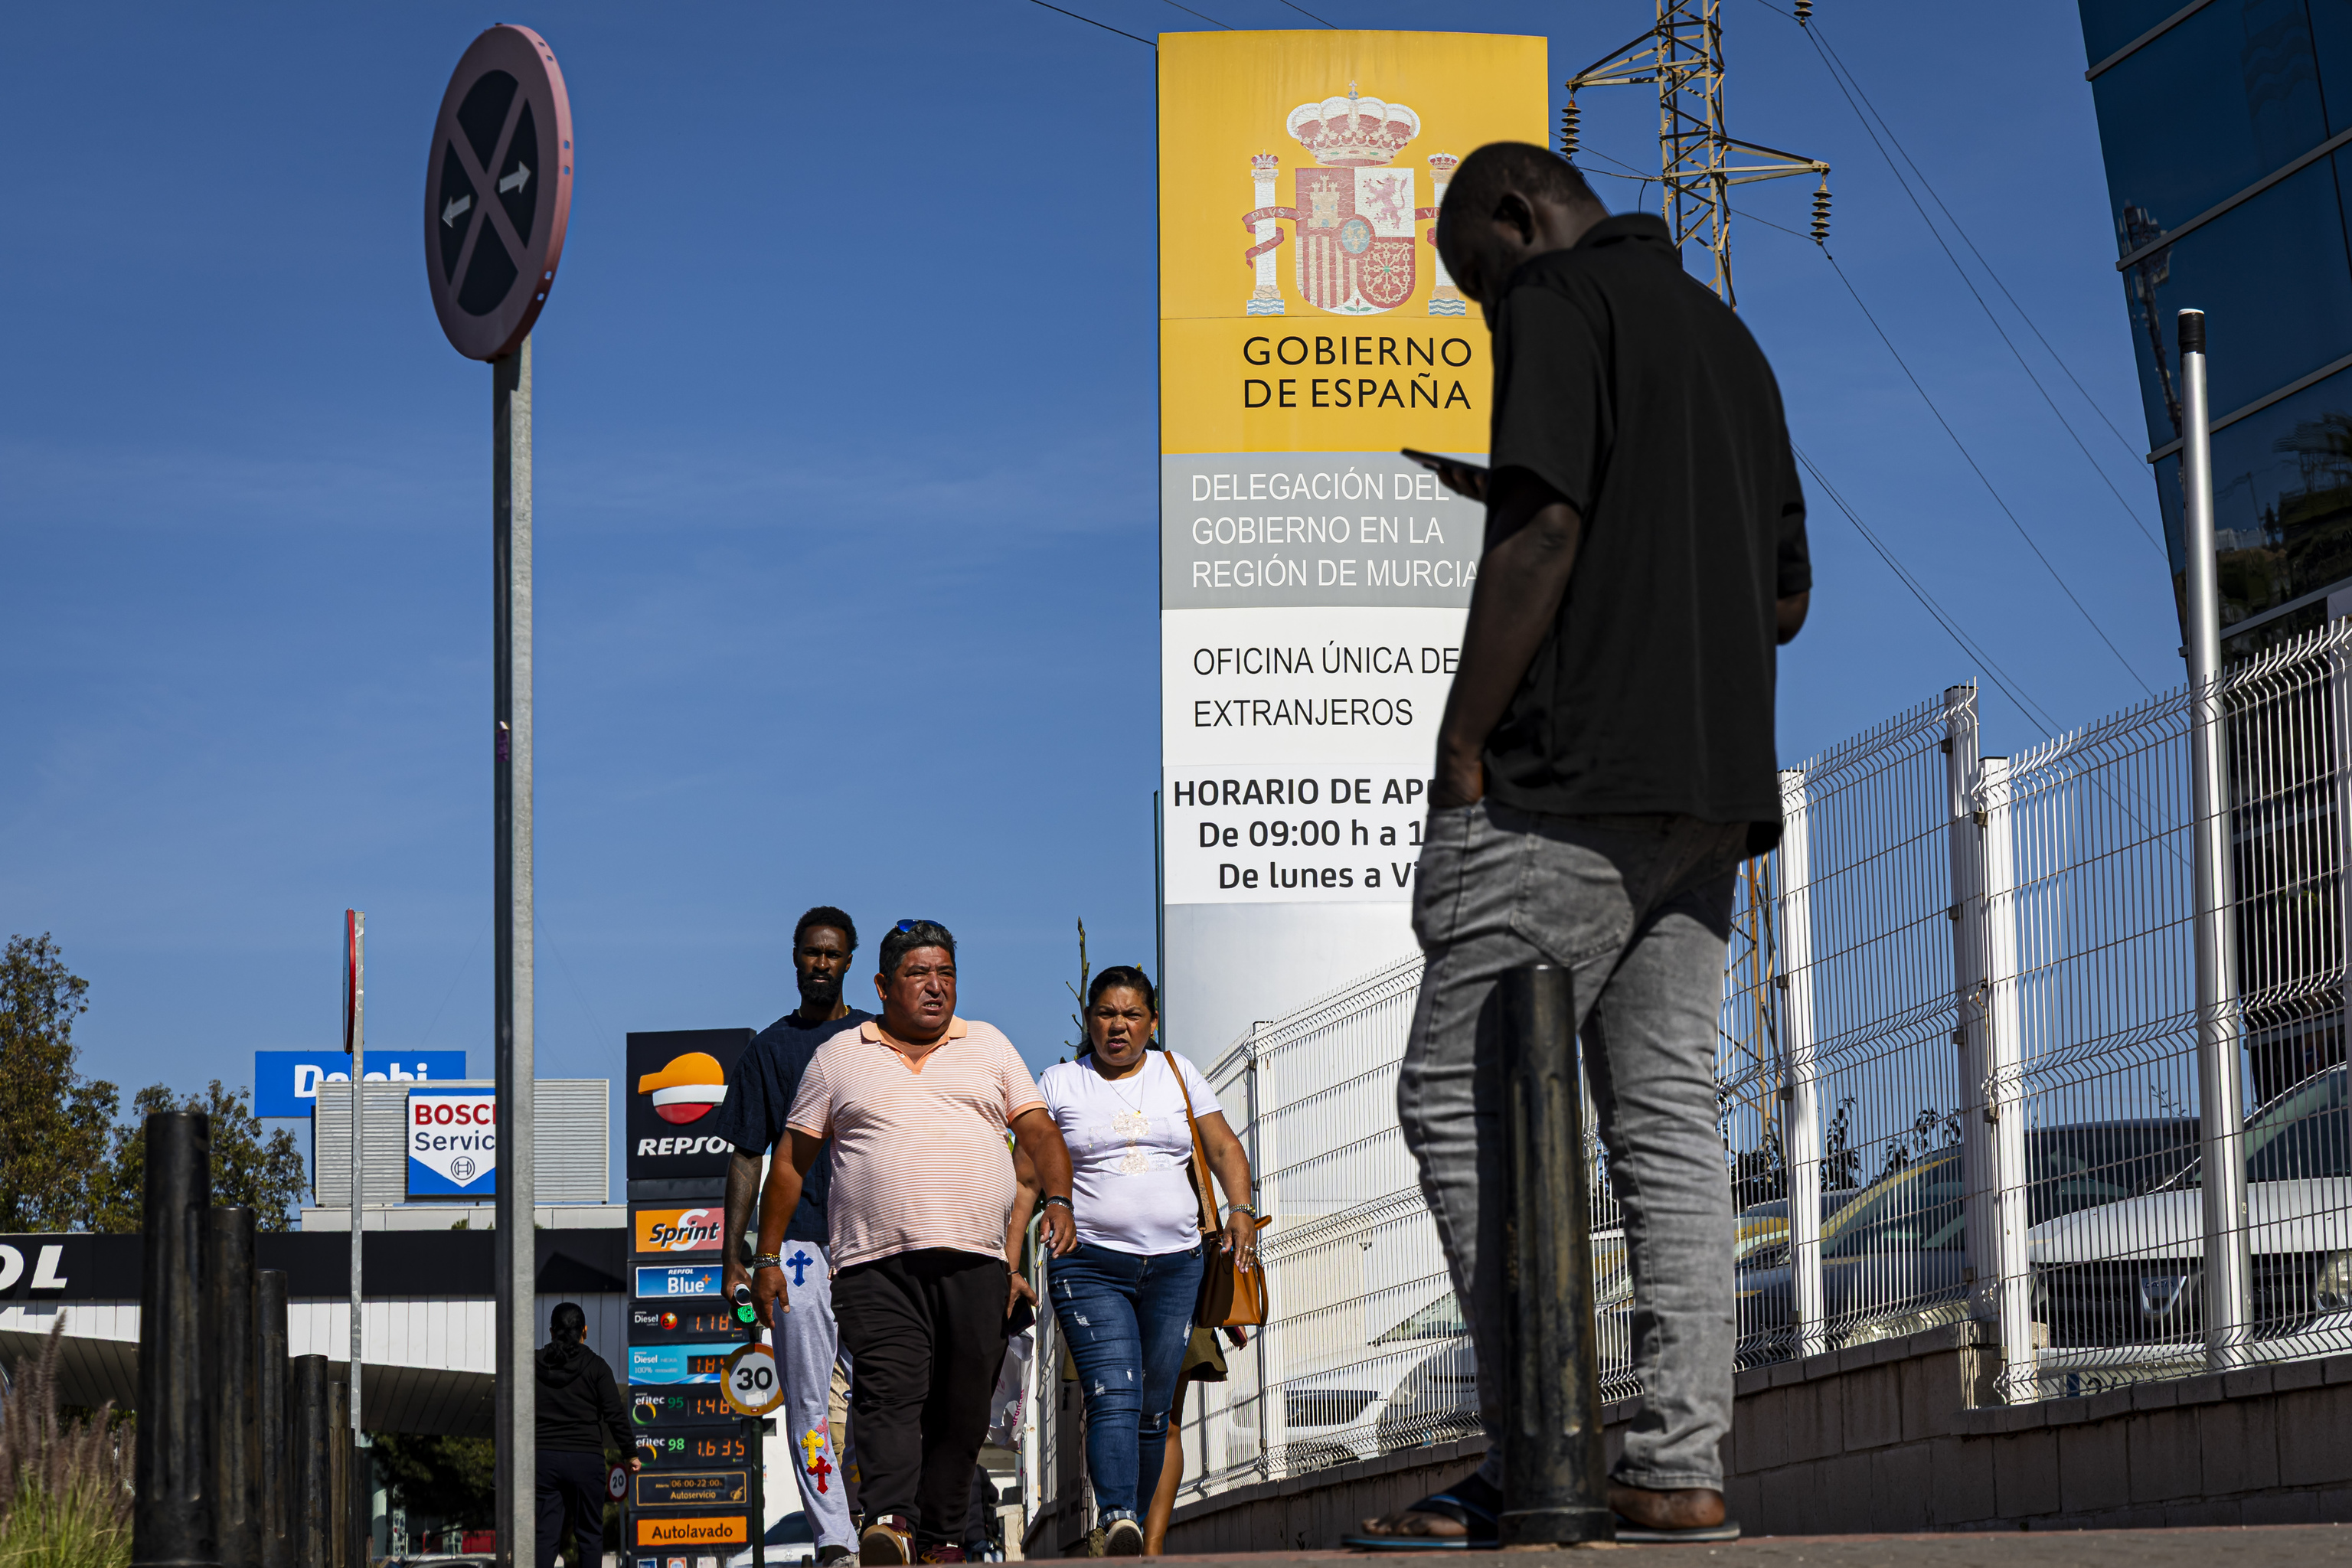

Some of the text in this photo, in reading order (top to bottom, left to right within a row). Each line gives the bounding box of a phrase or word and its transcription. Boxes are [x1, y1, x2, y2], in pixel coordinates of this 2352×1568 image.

[1243, 336, 1472, 367] GOBIERNO
[1244, 372, 1472, 410] DE ESPAÑA
[1192, 467, 1449, 501] DELEGACIÓN DEL
[1192, 516, 1444, 545] GOBIERNO EN LA
[1193, 554, 1478, 588] REGIÓN DE MURCIA
[1194, 641, 1459, 676] OFICINA ÚNICA DE
[1194, 698, 1413, 727] EXTRANJEROS
[1174, 779, 1432, 807] HORARIO DE AP
[1200, 822, 1239, 848] De
[1249, 820, 1340, 847] 09:00
[1351, 819, 1368, 846] h
[1380, 826, 1396, 846] a
[1219, 863, 1258, 890] De
[1270, 861, 1354, 888] lunes
[1364, 867, 1381, 888] a
[414, 1130, 495, 1151] Servic
[649, 1220, 721, 1249] Sprint
[635, 1314, 658, 1323] Diesel
[634, 1354, 658, 1364] Diesel
[737, 1367, 773, 1390] 30
[668, 1396, 684, 1409] 95
[668, 1437, 684, 1451] 98
[612, 1475, 624, 1489] 20
[670, 1490, 717, 1500] Autoservicio
[652, 1523, 733, 1540] Autolavado
